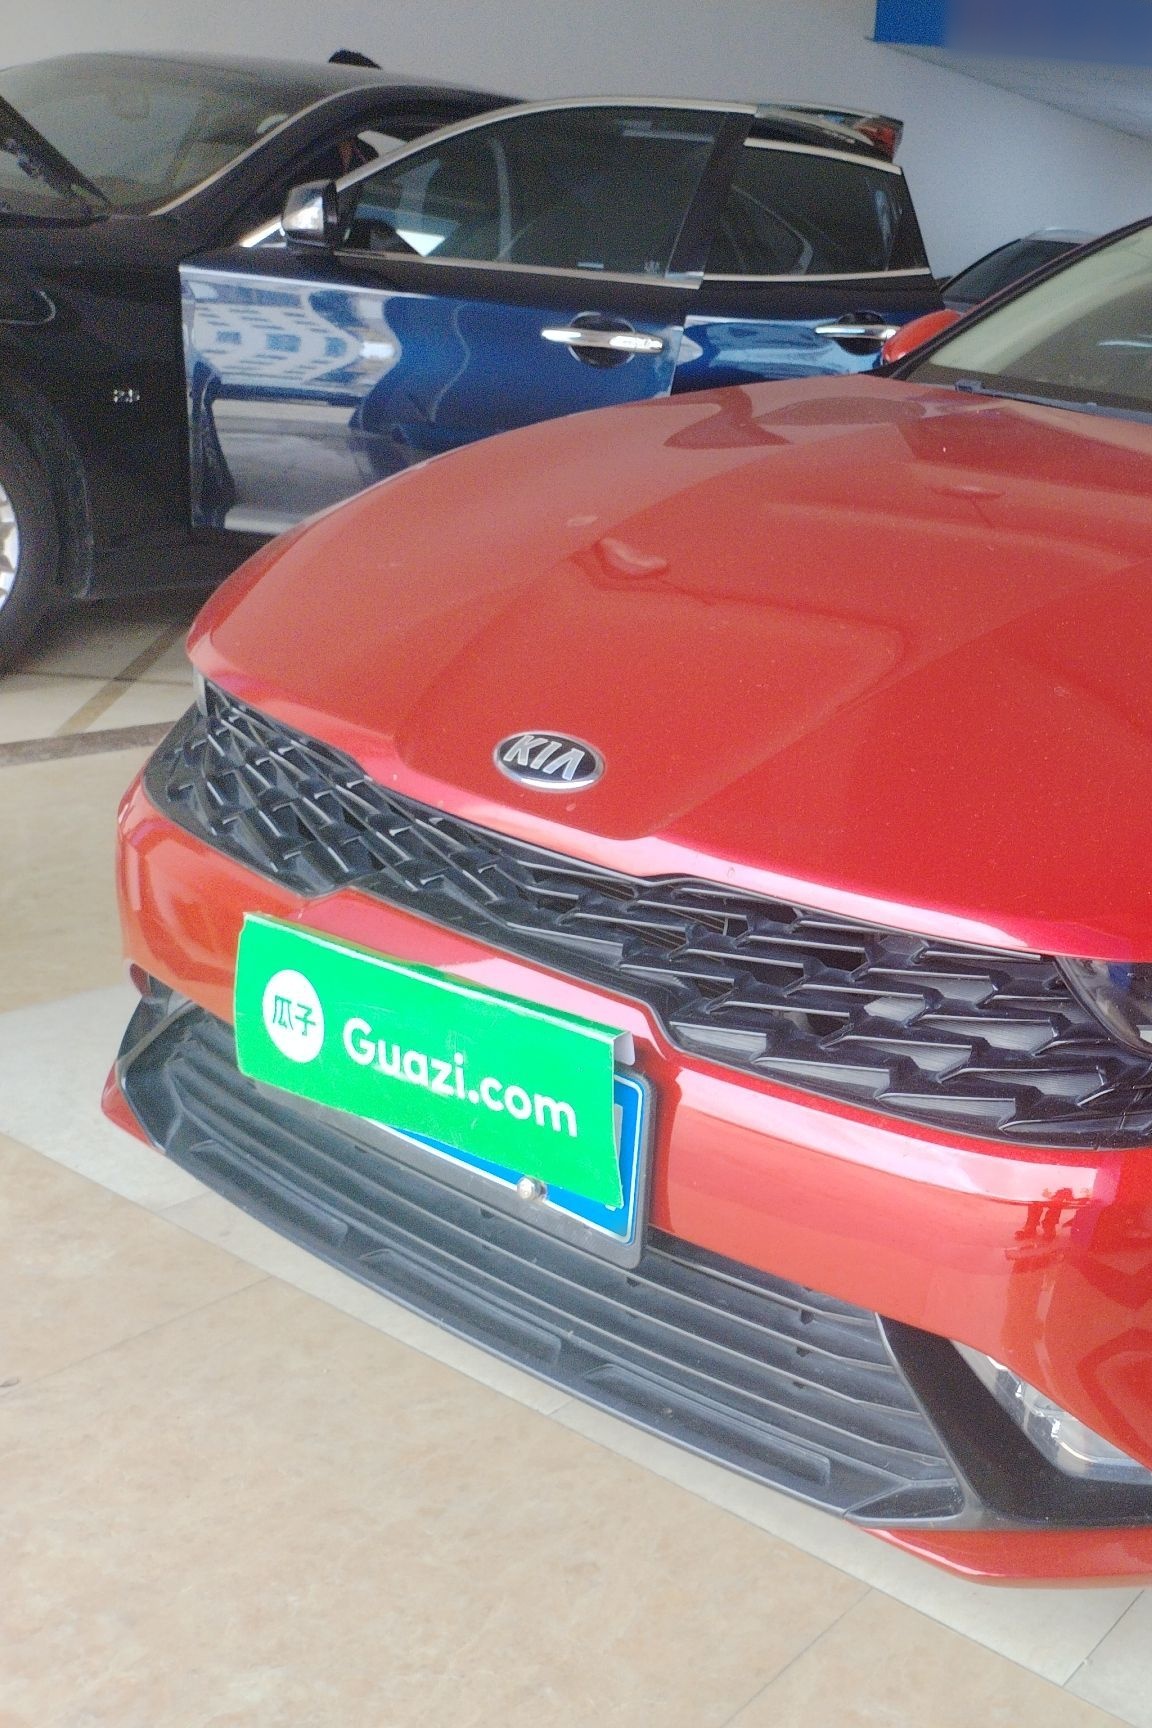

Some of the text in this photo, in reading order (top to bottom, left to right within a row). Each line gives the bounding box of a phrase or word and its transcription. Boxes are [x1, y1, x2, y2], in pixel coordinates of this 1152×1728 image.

[503, 735, 585, 780] KIA
[272, 995, 317, 1036] 瓜子
[342, 1017, 578, 1138] Guazi.com
